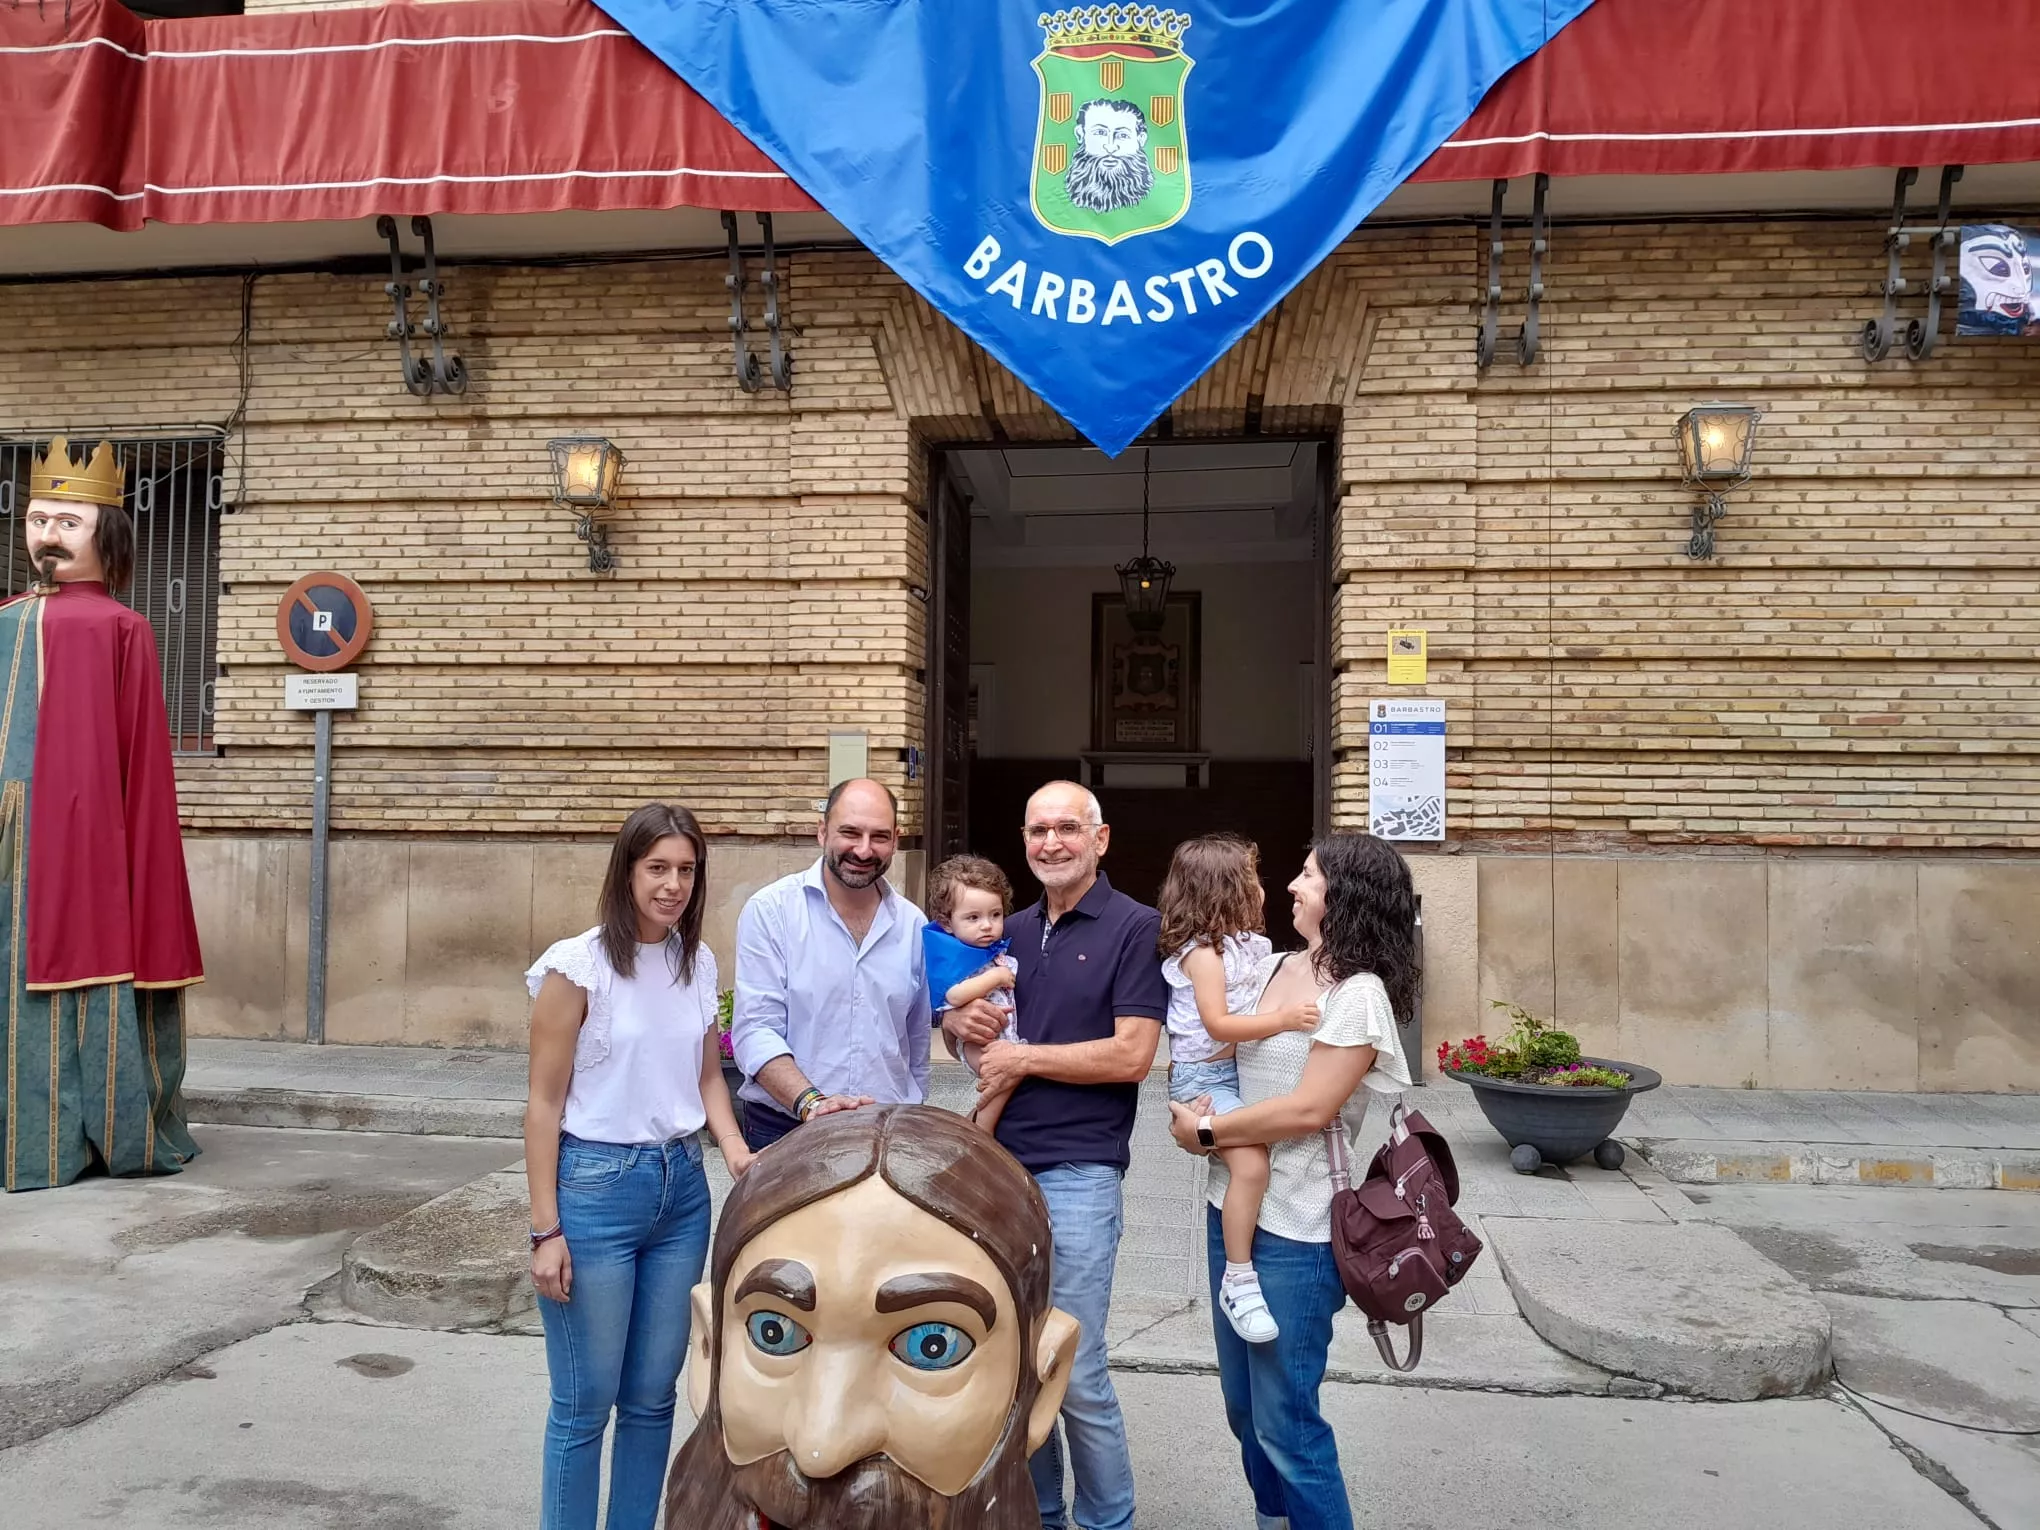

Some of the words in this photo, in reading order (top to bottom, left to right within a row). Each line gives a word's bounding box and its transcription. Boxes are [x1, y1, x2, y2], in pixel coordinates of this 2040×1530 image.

[962, 231, 1274, 326] BARBASTRO
[319, 614, 327, 628] P
[1374, 723, 1387, 733] 01
[1373, 741, 1388, 750] 02
[1373, 760, 1388, 768] 03
[1373, 777, 1388, 786] 04
